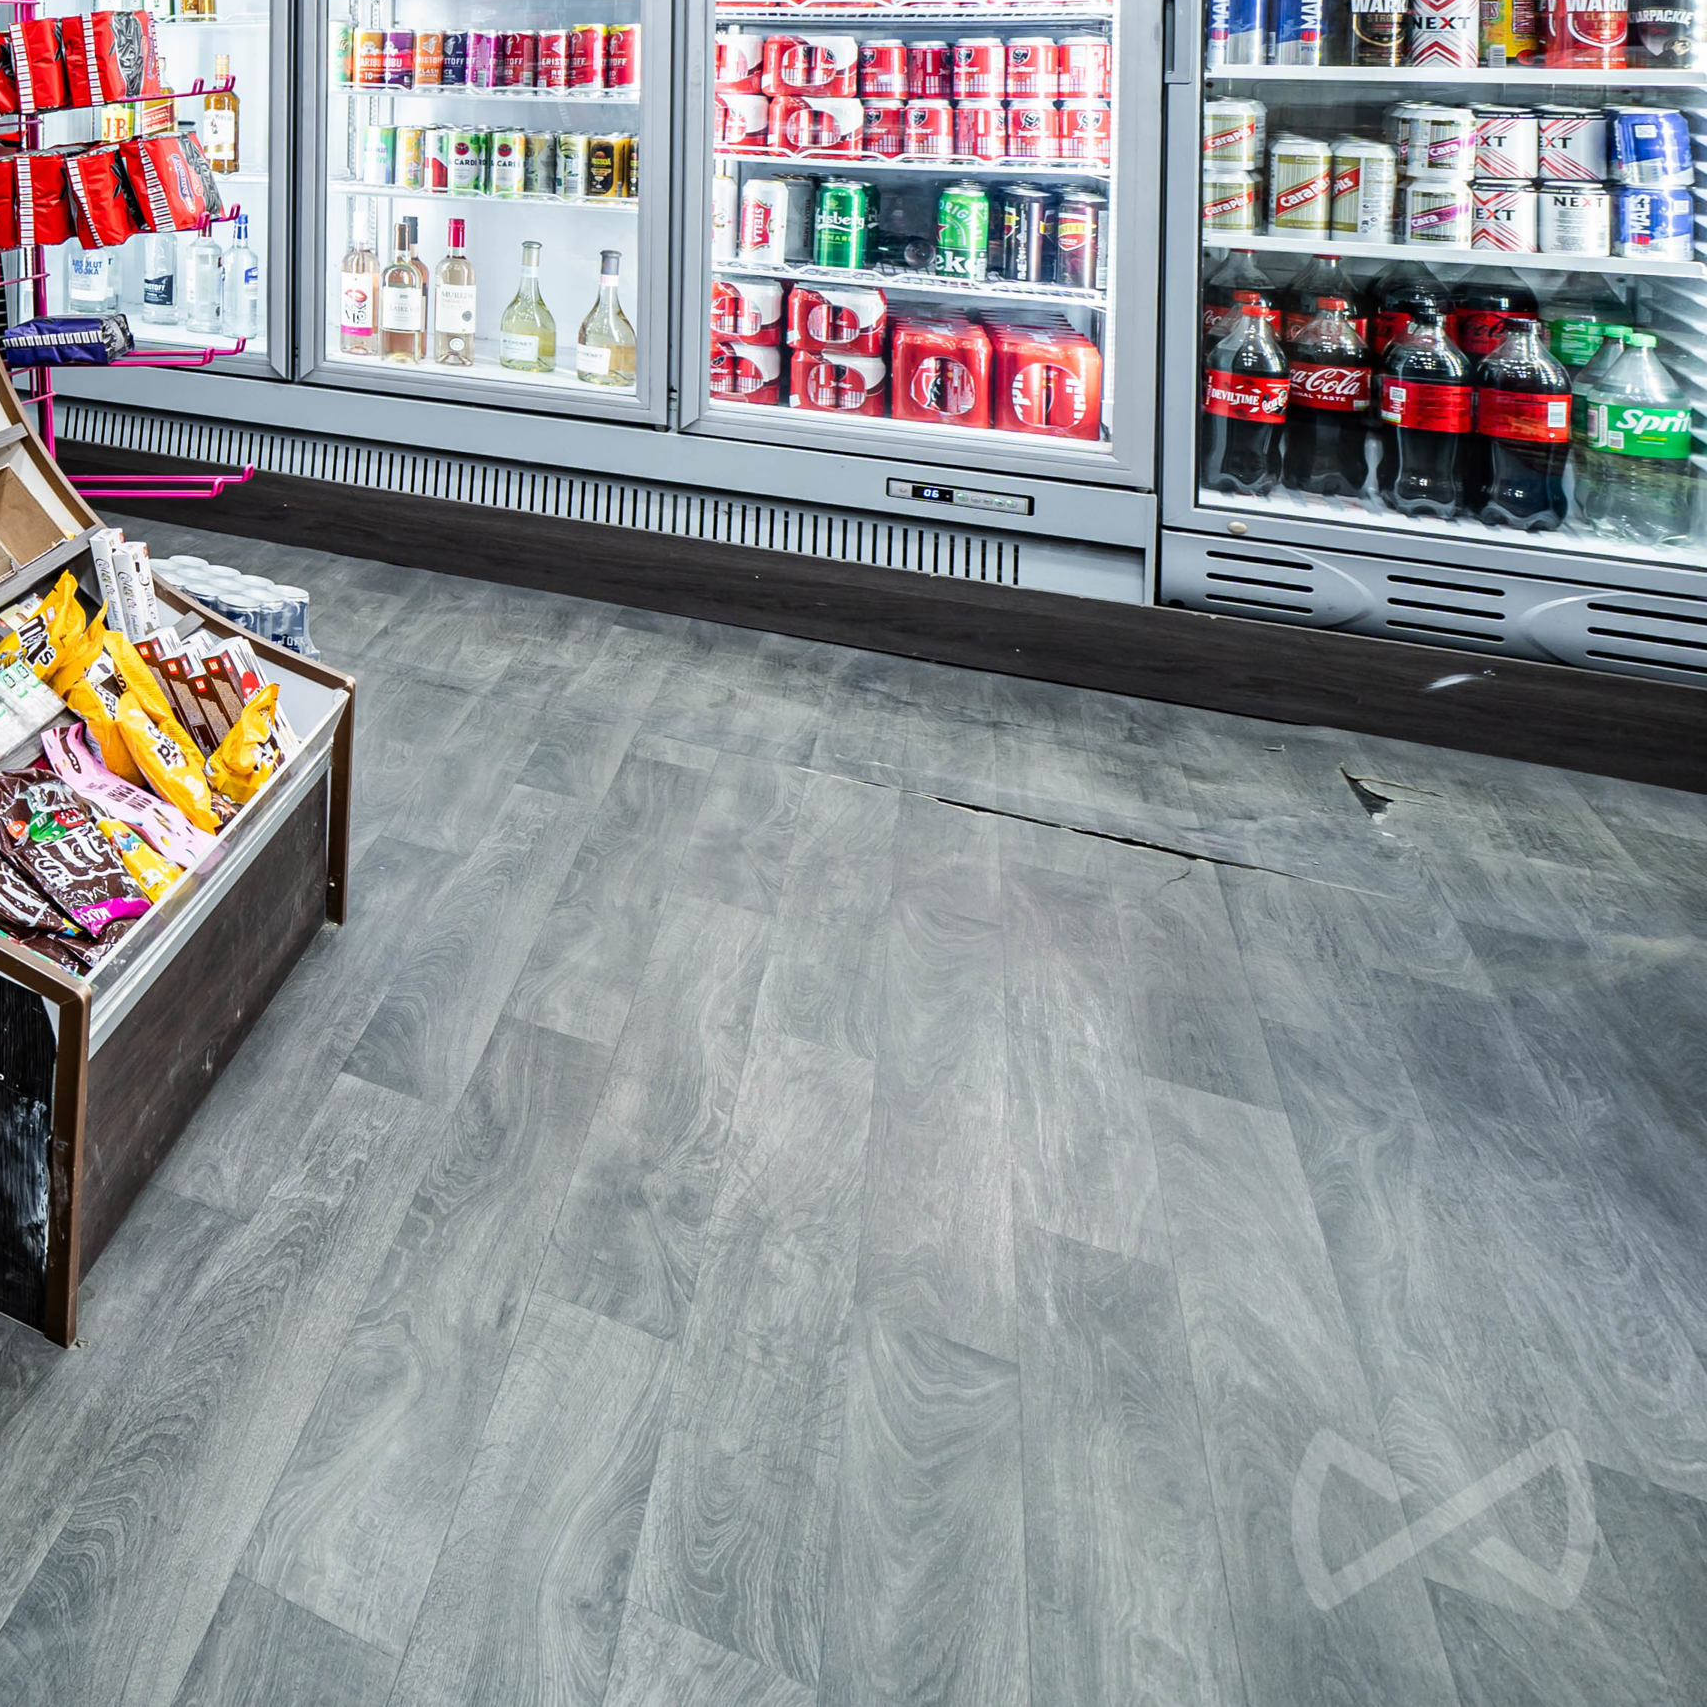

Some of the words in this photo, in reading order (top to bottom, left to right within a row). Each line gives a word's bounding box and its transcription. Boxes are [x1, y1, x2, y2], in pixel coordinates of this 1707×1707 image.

[1412, 14, 1471, 32] NEXT
[1552, 195, 1604, 210] NEXT
[1631, 194, 1651, 234] MAES
